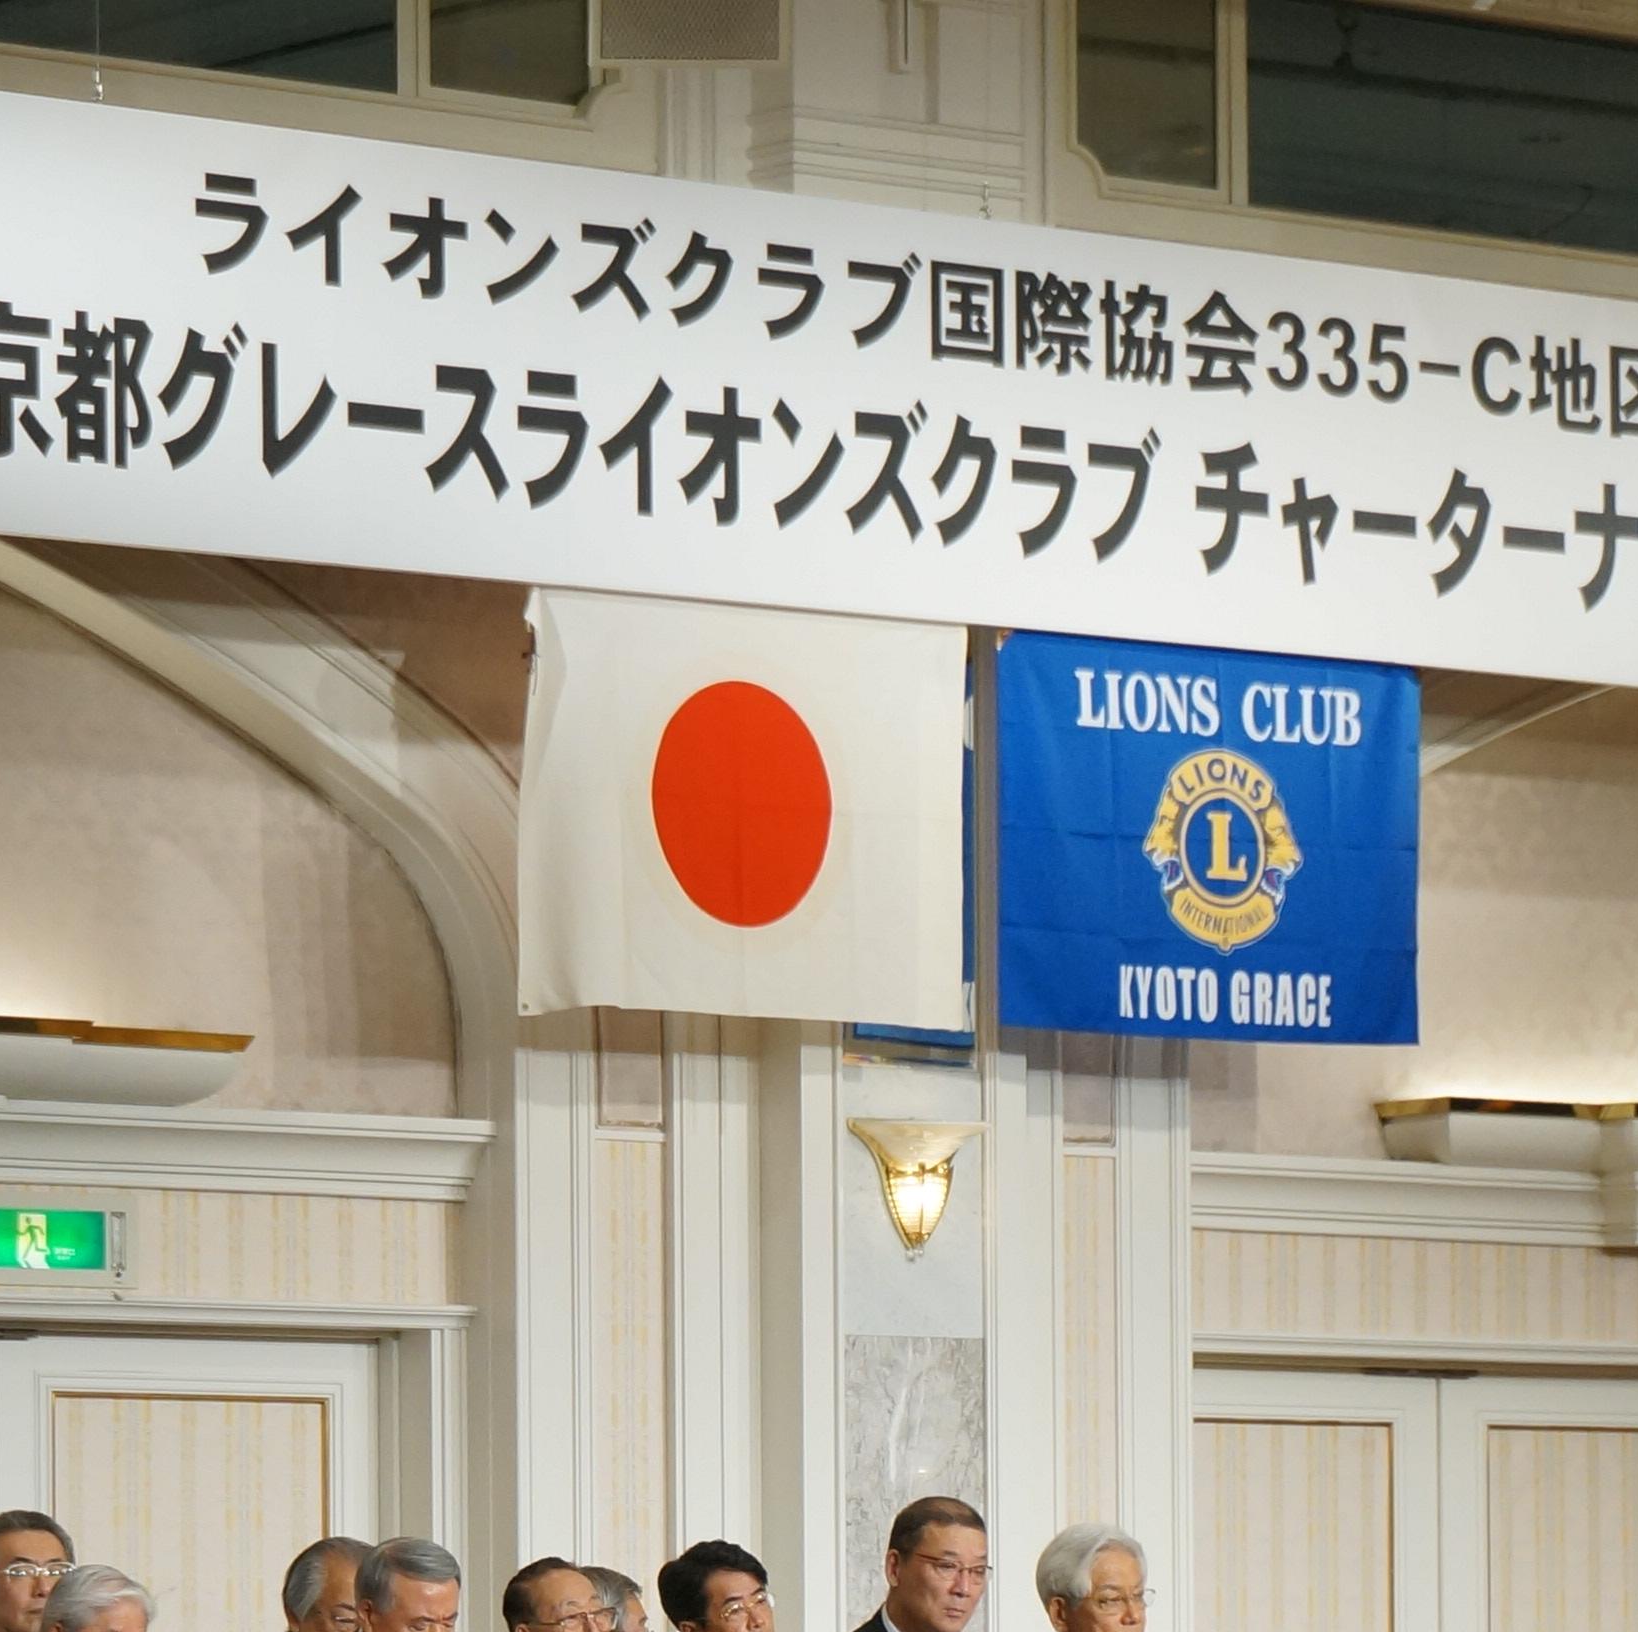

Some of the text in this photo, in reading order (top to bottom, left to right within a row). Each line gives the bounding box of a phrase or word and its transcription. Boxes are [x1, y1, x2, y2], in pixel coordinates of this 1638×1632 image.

[1074, 667, 1362, 747] LIONS CLUB
[1177, 757, 1266, 801] LIONS
[1205, 810, 1249, 882] L
[1180, 896, 1269, 937] INTERNATIONAL
[1118, 963, 1332, 1028] KYOTO GRACE
